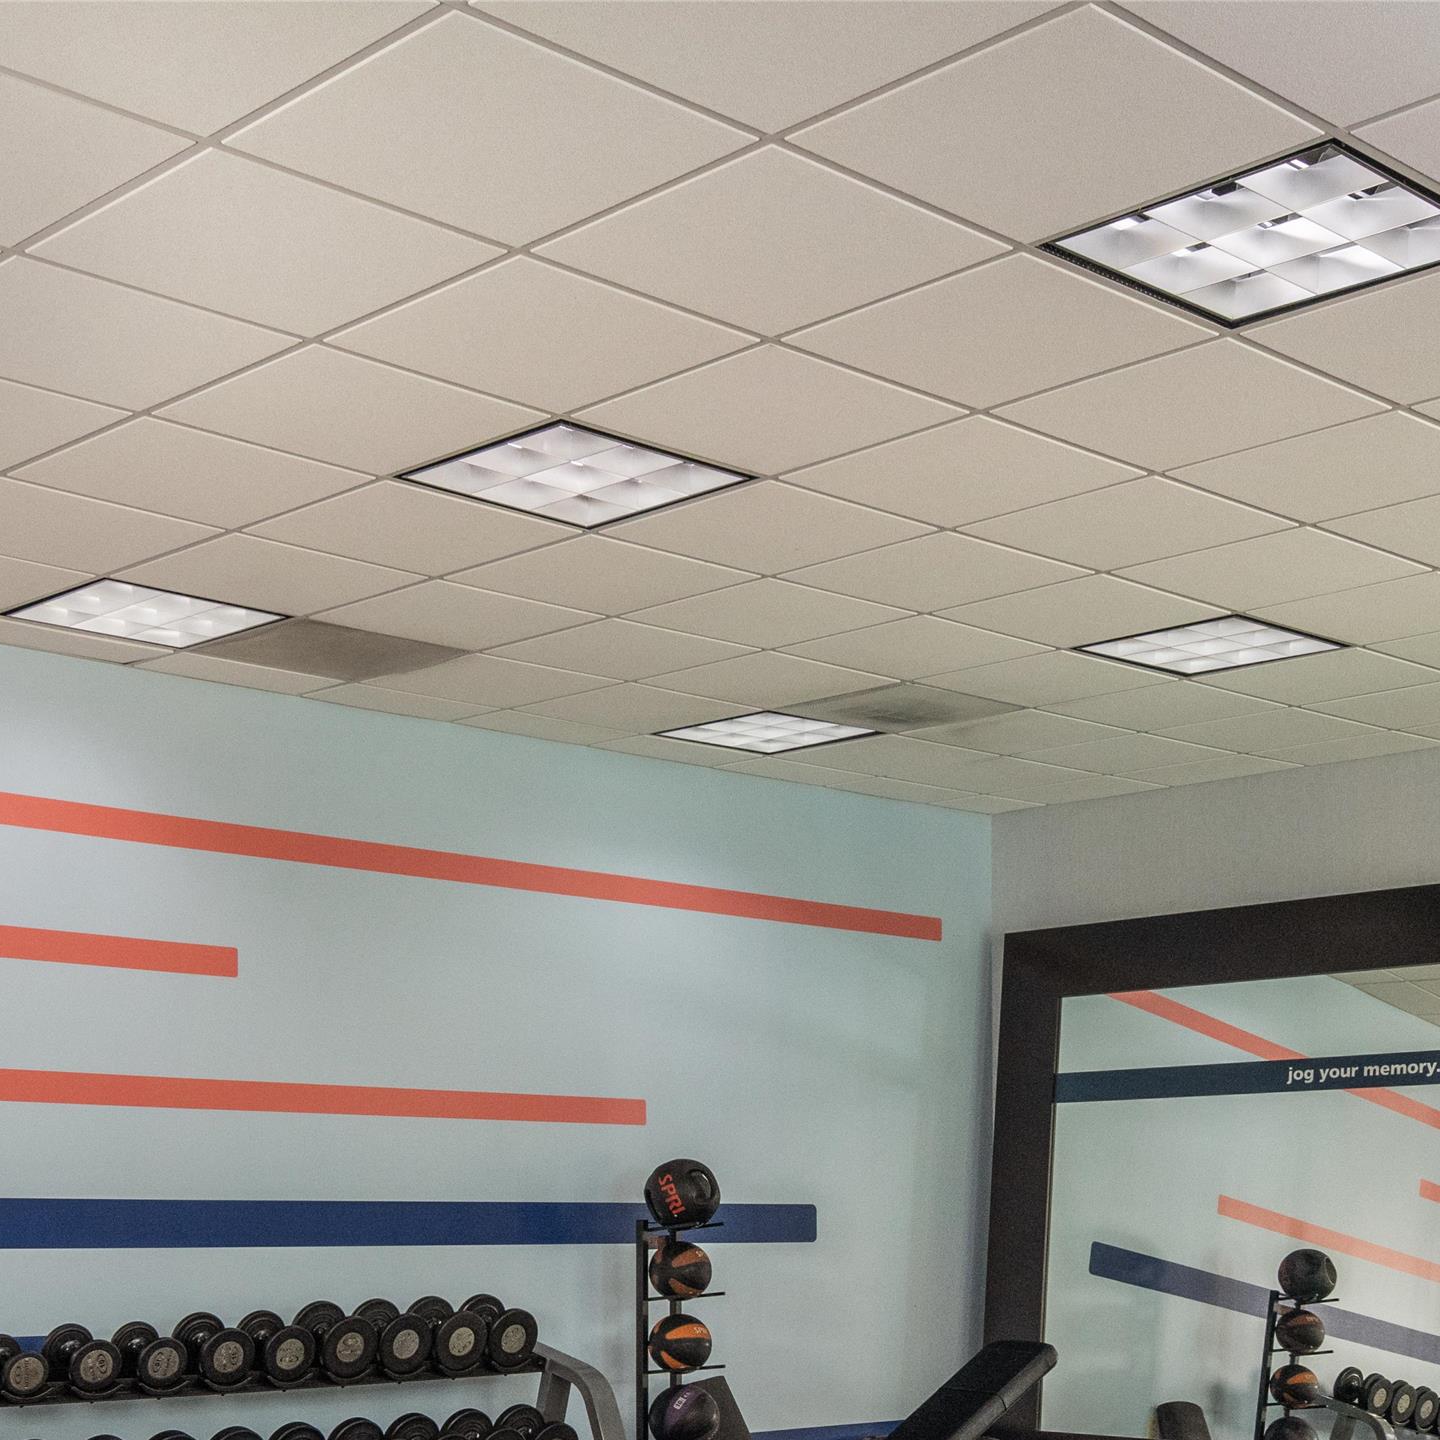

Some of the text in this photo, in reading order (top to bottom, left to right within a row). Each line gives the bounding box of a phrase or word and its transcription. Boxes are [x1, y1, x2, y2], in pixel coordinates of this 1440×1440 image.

[1286, 1061, 1440, 1085] jog your memory.
[658, 1173, 687, 1215] SPRI
